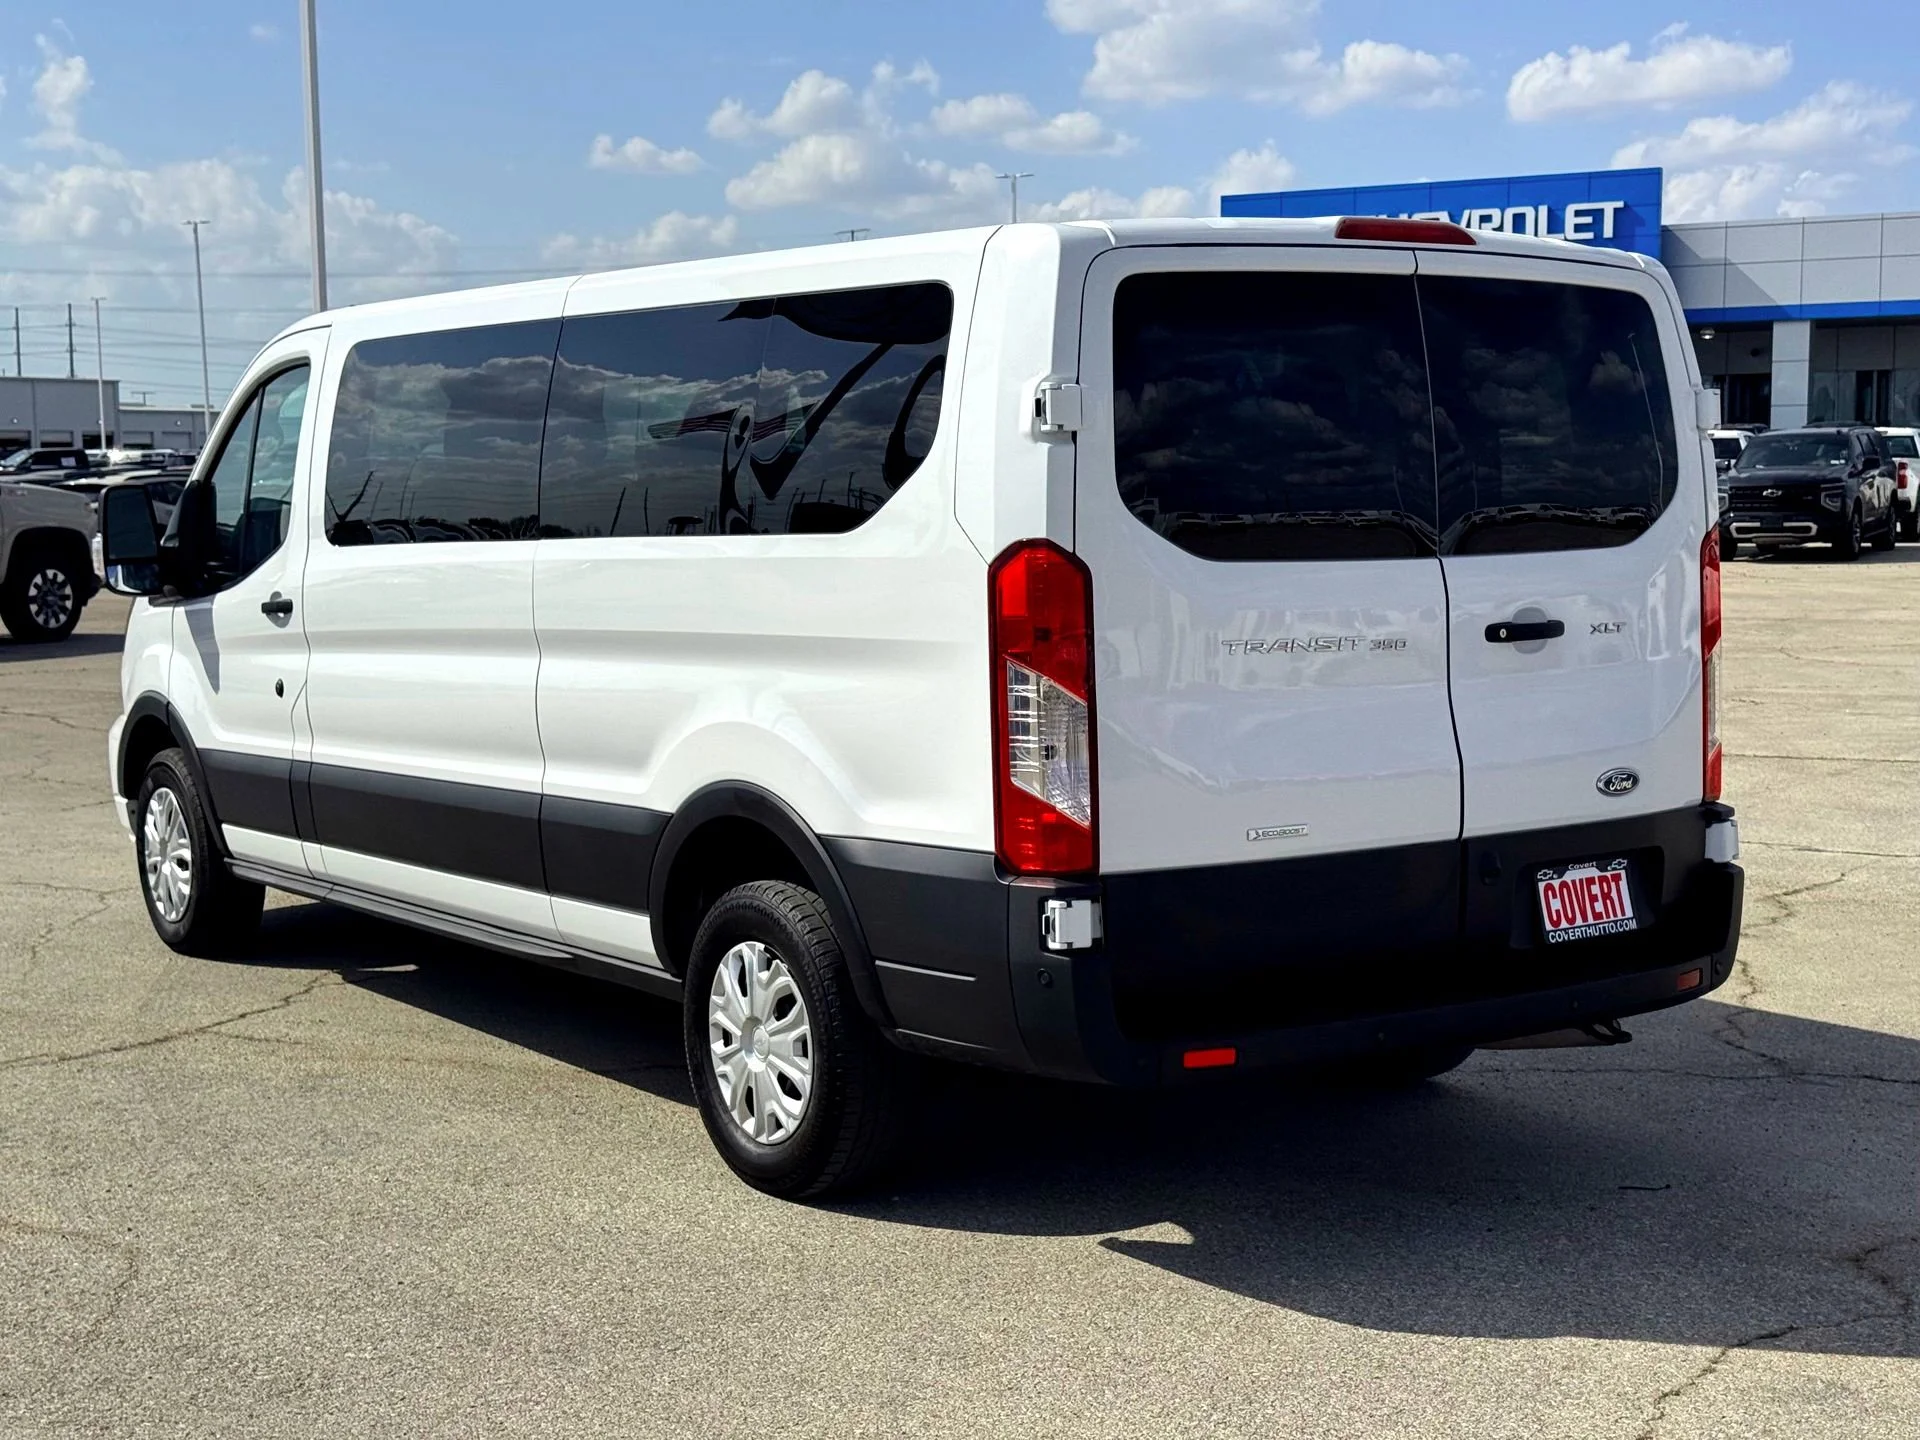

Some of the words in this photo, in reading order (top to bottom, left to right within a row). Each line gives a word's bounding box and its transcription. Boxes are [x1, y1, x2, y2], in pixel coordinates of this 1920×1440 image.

[1589, 622, 1627, 635] XLT
[1221, 636, 1366, 655] TRANSIT
[1369, 638, 1408, 651] 350
[1609, 774, 1634, 791] Ford
[1568, 861, 1597, 870] Covert
[1543, 872, 1627, 929] COVERT
[1548, 918, 1638, 943] COVERTHUTTO.COM
